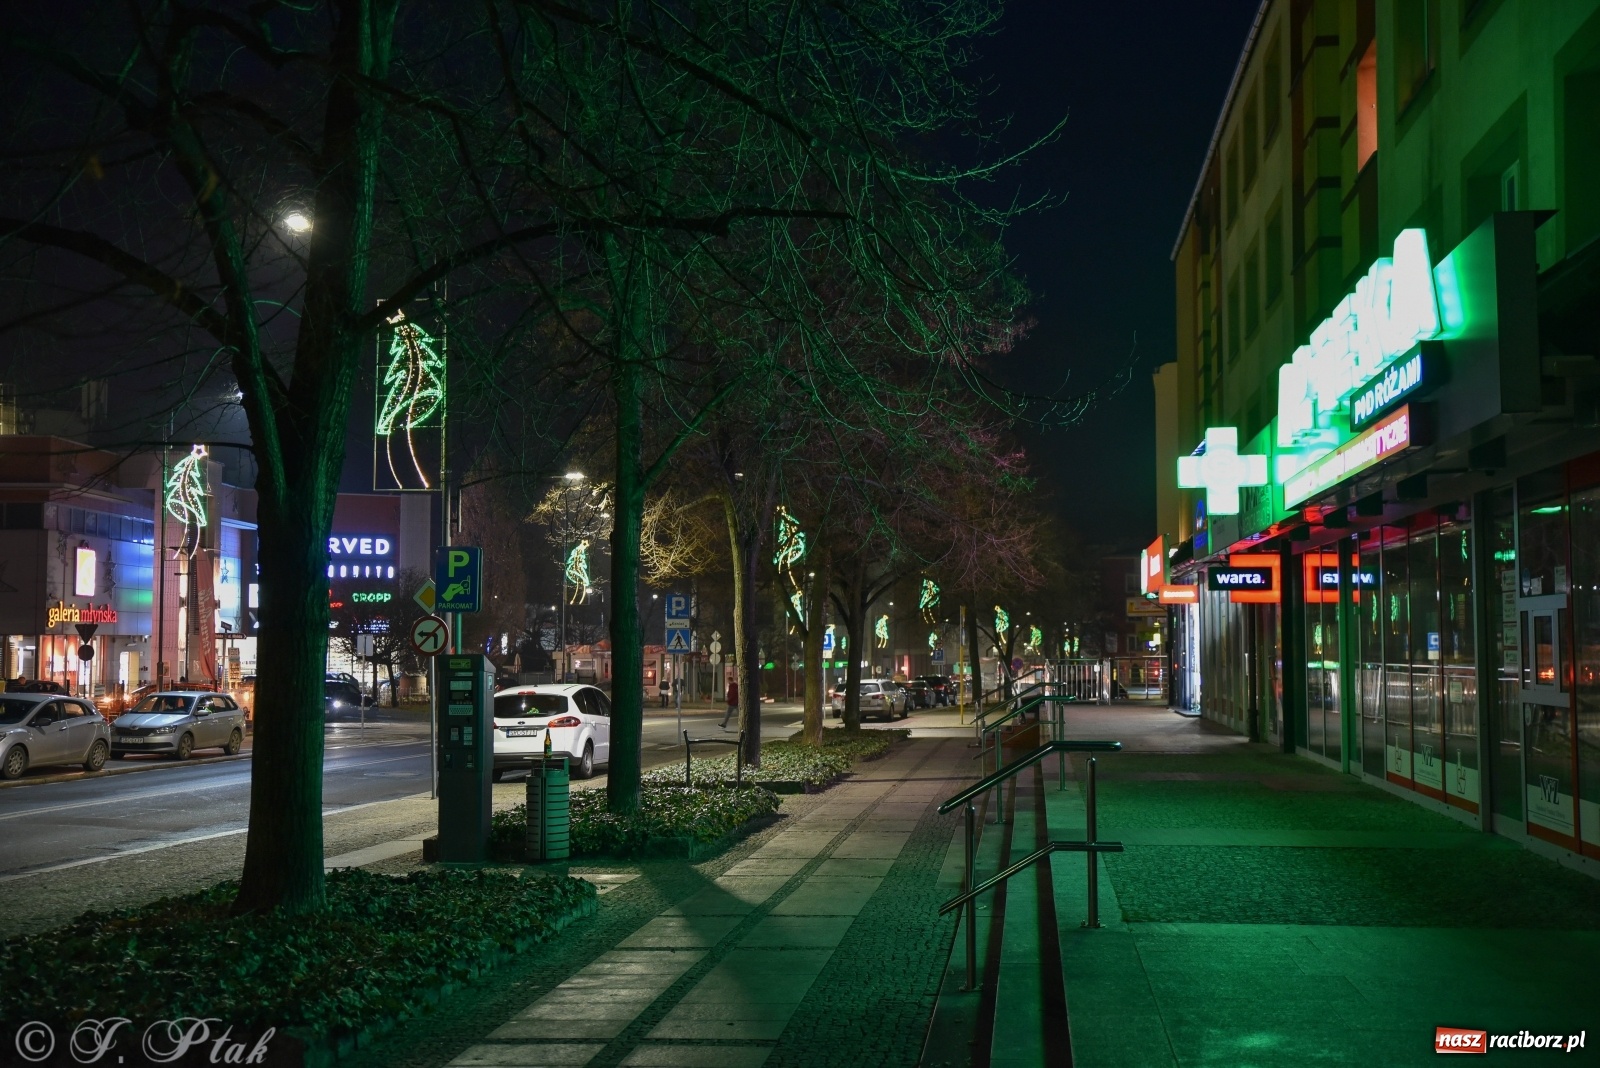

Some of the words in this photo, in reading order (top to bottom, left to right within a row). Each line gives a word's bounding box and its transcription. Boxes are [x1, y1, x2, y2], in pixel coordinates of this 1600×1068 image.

[1355, 390, 1375, 425] POD
[1374, 353, 1422, 410] RÓŻAMI
[329, 537, 390, 555] RVED
[448, 550, 470, 578] P
[352, 592, 392, 603] CROPP
[438, 602, 474, 610] PARKOMAT
[671, 596, 686, 616] P
[48, 601, 80, 628] galeria
[80, 603, 118, 625] młyńska
